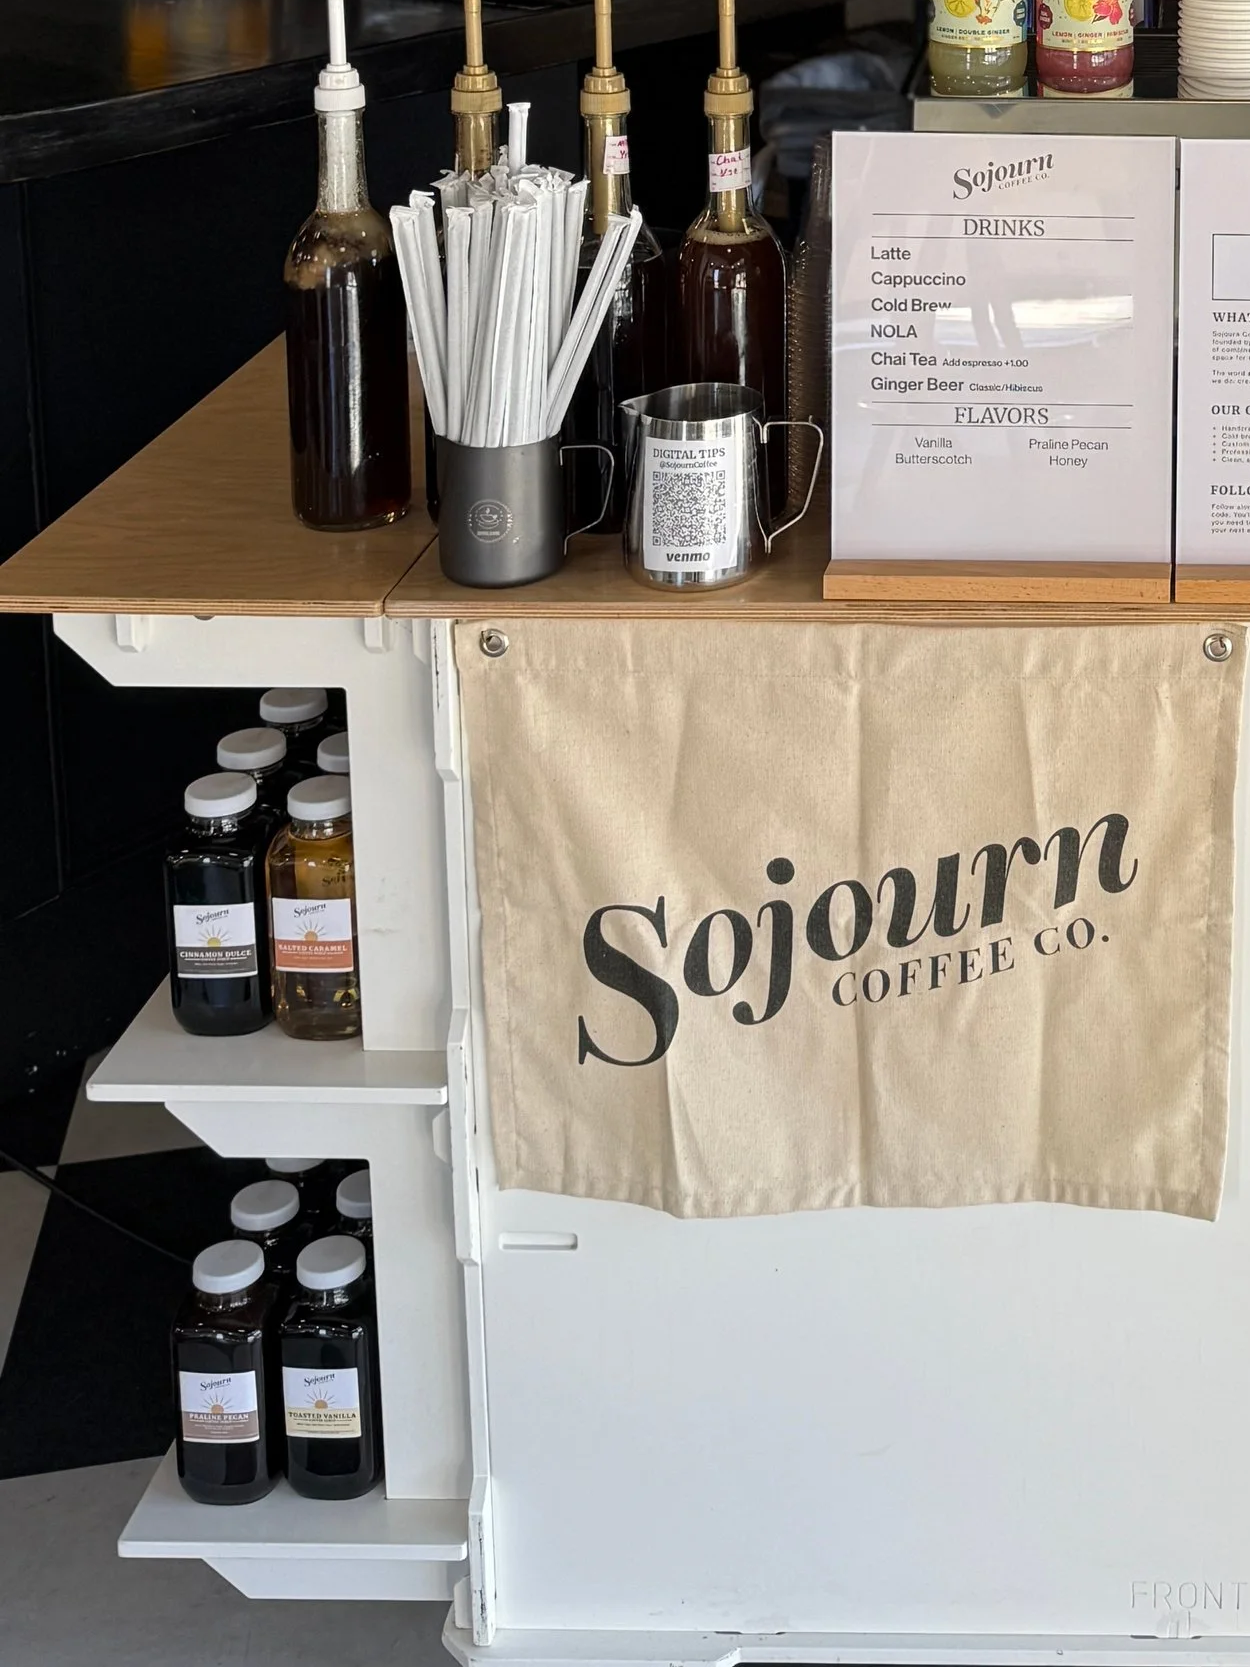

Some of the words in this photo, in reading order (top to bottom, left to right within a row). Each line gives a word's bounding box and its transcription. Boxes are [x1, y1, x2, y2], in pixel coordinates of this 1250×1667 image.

[953, 153, 1054, 200] Sojourn
[998, 176, 1033, 190] COFFEE
[1035, 172, 1050, 181] CO.
[963, 218, 1045, 237] DRINKS
[871, 246, 911, 261] Latte
[871, 271, 966, 288] Cappuccino
[871, 298, 908, 313] Cold
[911, 298, 952, 313] Brew
[871, 324, 918, 339] NOLA
[871, 352, 906, 367] Chai
[909, 352, 937, 367] Tea
[942, 358, 961, 368] Add
[962, 360, 1003, 370] espresso
[1004, 359, 1029, 368] +1.00
[871, 377, 924, 394] Ginger
[927, 378, 964, 392] Beer
[969, 382, 1044, 394] Classic/Hibiscus
[954, 406, 1049, 426] FLAVORS
[1211, 404, 1241, 416] OUR
[915, 437, 953, 449] Vanilla
[1029, 438, 1069, 452] Praline
[1071, 439, 1109, 451] Pecan
[653, 448, 697, 460] DIGITAL
[698, 447, 726, 459] TIPS
[895, 453, 973, 466] Butterscotch
[1049, 455, 1089, 469] Honey
[666, 552, 711, 562] venmo
[196, 909, 229, 925] Sojourn
[293, 902, 326, 918] Sojourn
[578, 812, 1139, 1068] Sojourn
[180, 950, 224, 958] CINNAMON
[225, 949, 252, 957] DULCE
[308, 944, 348, 952] CARAMEL
[831, 936, 1016, 1008] COFFEE
[1033, 916, 1111, 958] CO.
[200, 1376, 232, 1391] Sojourn
[303, 1373, 336, 1388] Sojourn
[288, 1411, 322, 1419] TOASTED
[323, 1411, 357, 1419] VANILLA
[1129, 1579, 1249, 1611] FRONT
